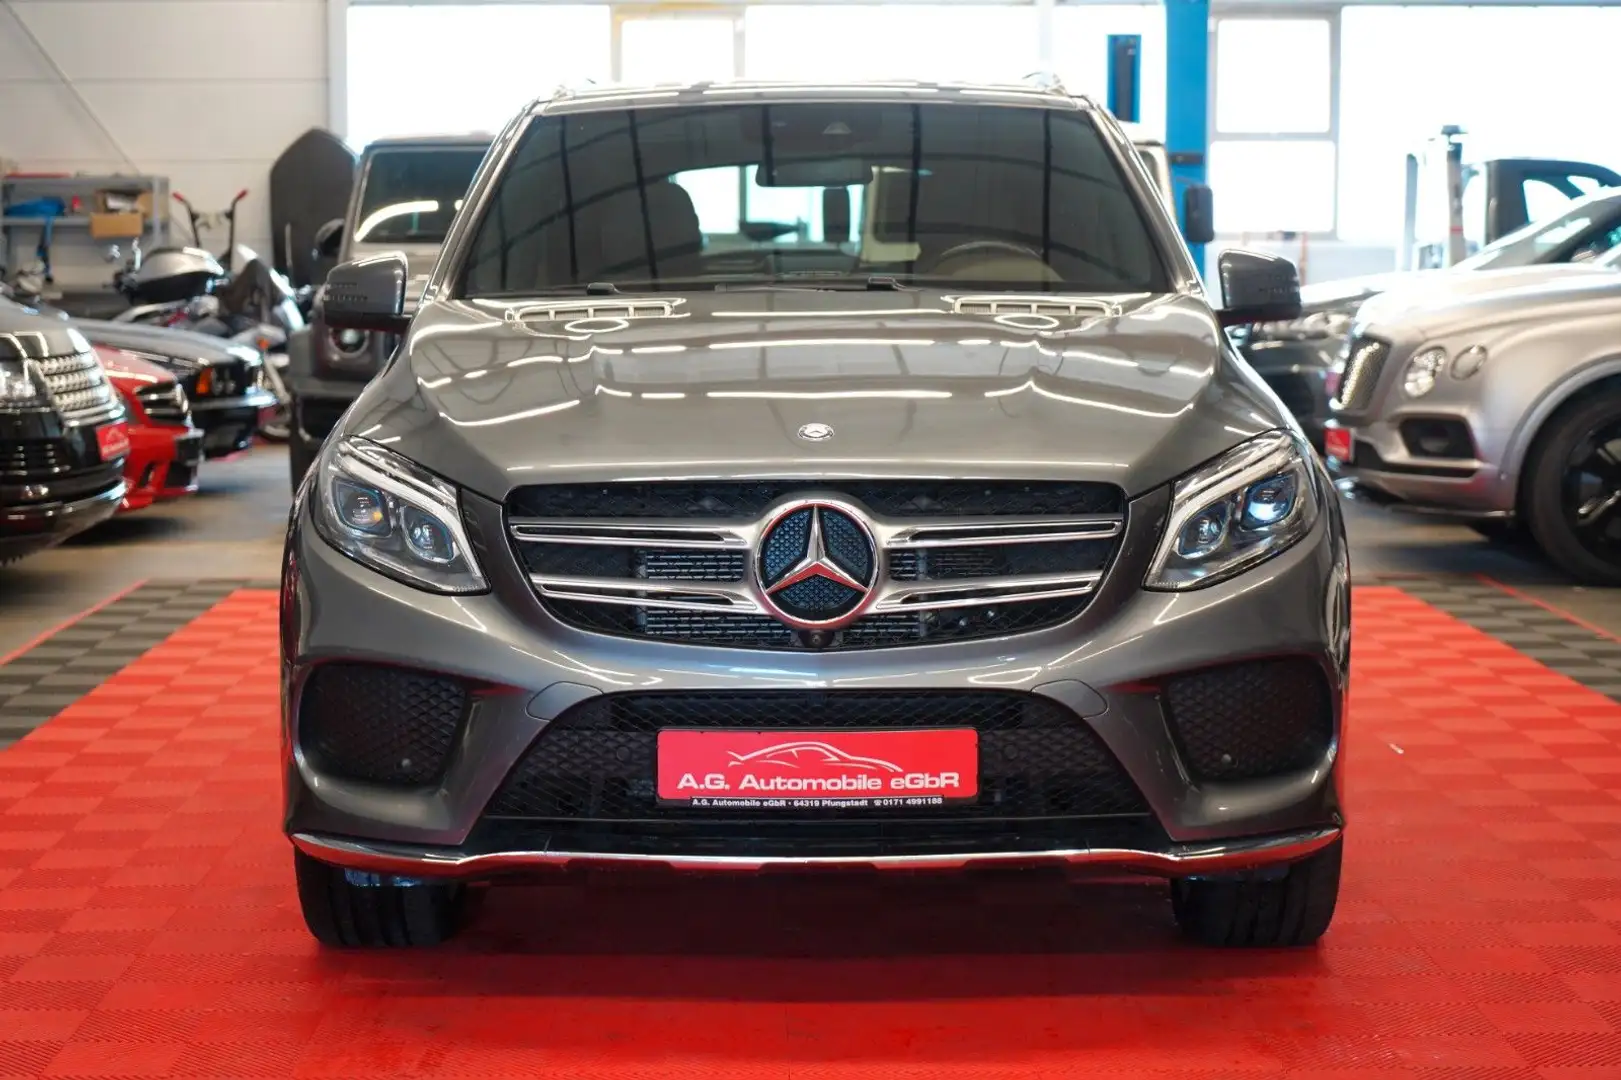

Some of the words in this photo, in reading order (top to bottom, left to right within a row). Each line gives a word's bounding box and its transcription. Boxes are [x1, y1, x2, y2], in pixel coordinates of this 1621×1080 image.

[677, 773, 730, 790] A.G.
[739, 773, 882, 791] Automobile
[890, 771, 960, 790] eGbR
[692, 798, 711, 806] A.G.
[712, 799, 760, 807] Automobile
[821, 799, 868, 808] Pfungstadt
[883, 798, 903, 806] 0171
